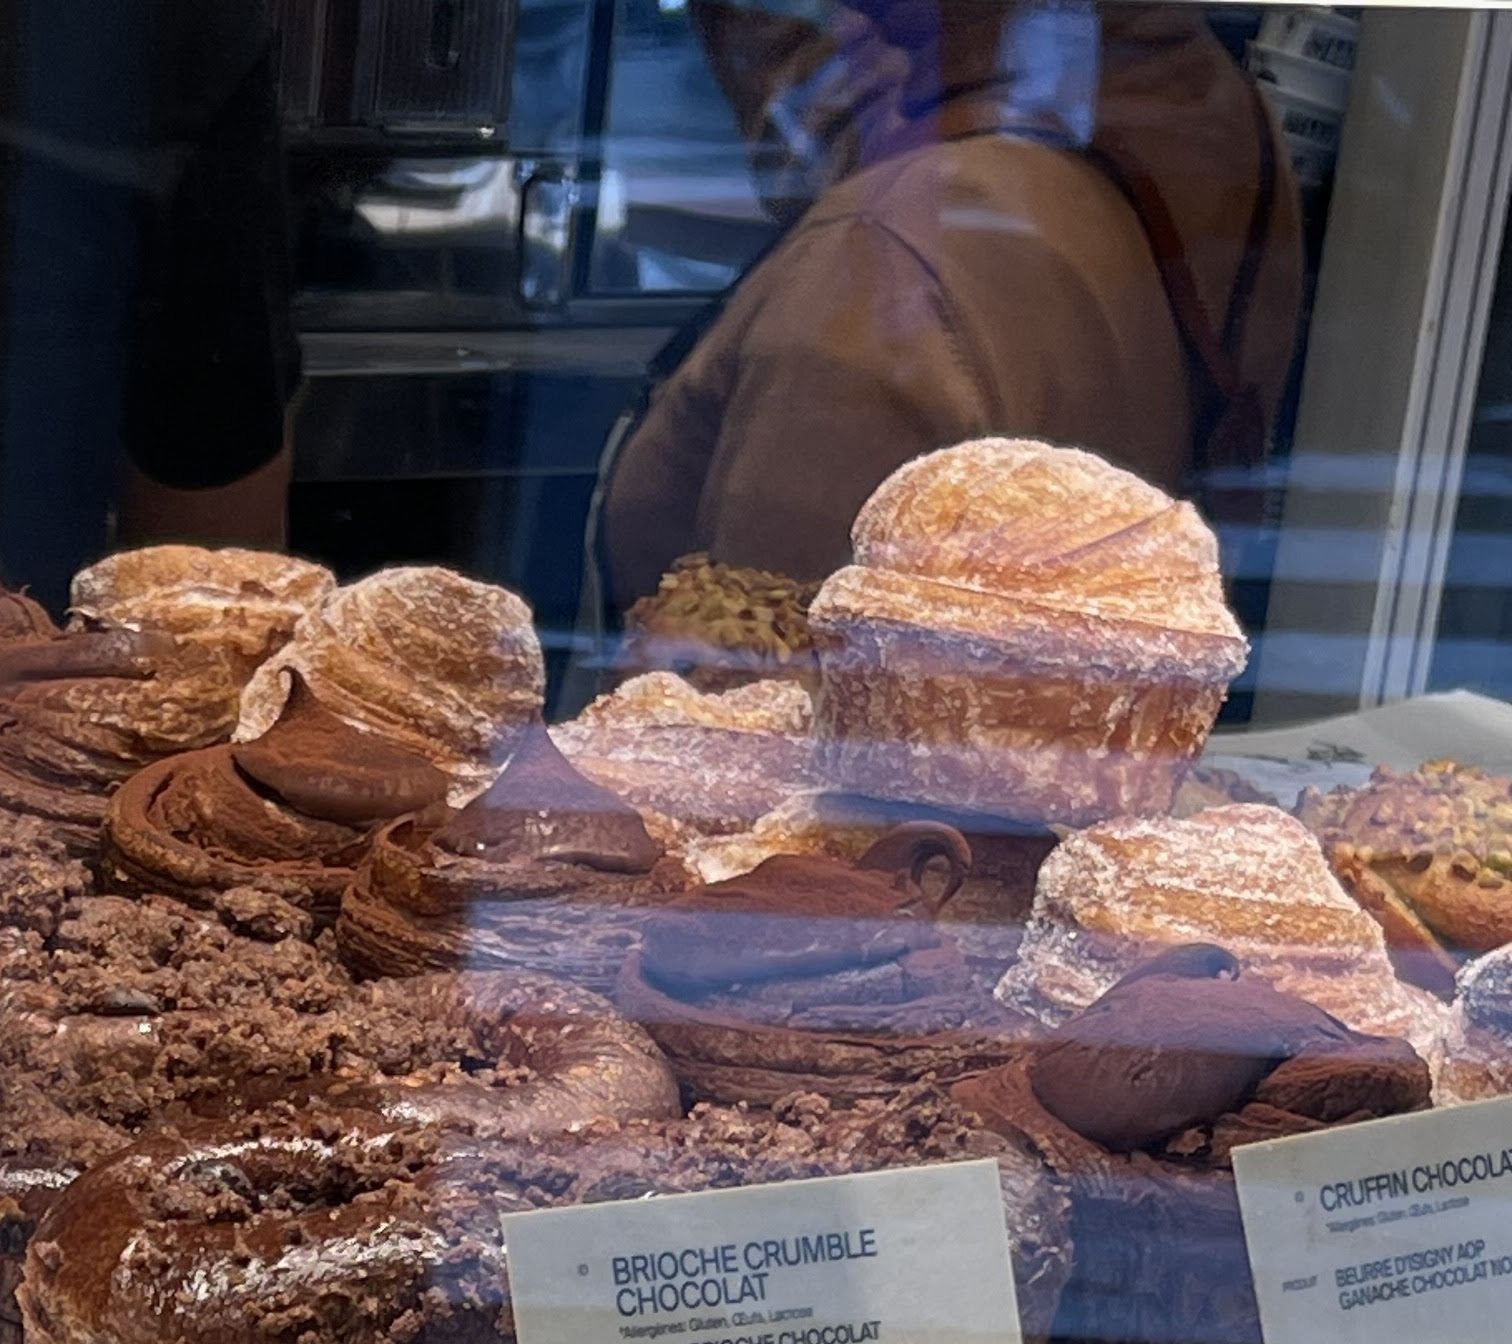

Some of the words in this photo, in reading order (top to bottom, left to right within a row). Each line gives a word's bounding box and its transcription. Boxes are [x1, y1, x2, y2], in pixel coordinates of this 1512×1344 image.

[1320, 1170, 1408, 1212] CRUFFIN
[1412, 1148, 1512, 1193] CHOCOLA
[611, 1245, 738, 1286] BRIOCHE
[742, 1229, 878, 1271] CRUMBLE
[1336, 1259, 1393, 1287] BEURRE
[616, 1273, 769, 1317] CHOCOLAT
[1339, 1278, 1411, 1310] GANACHE
[1412, 1263, 1487, 1294] CHOCOLAT
